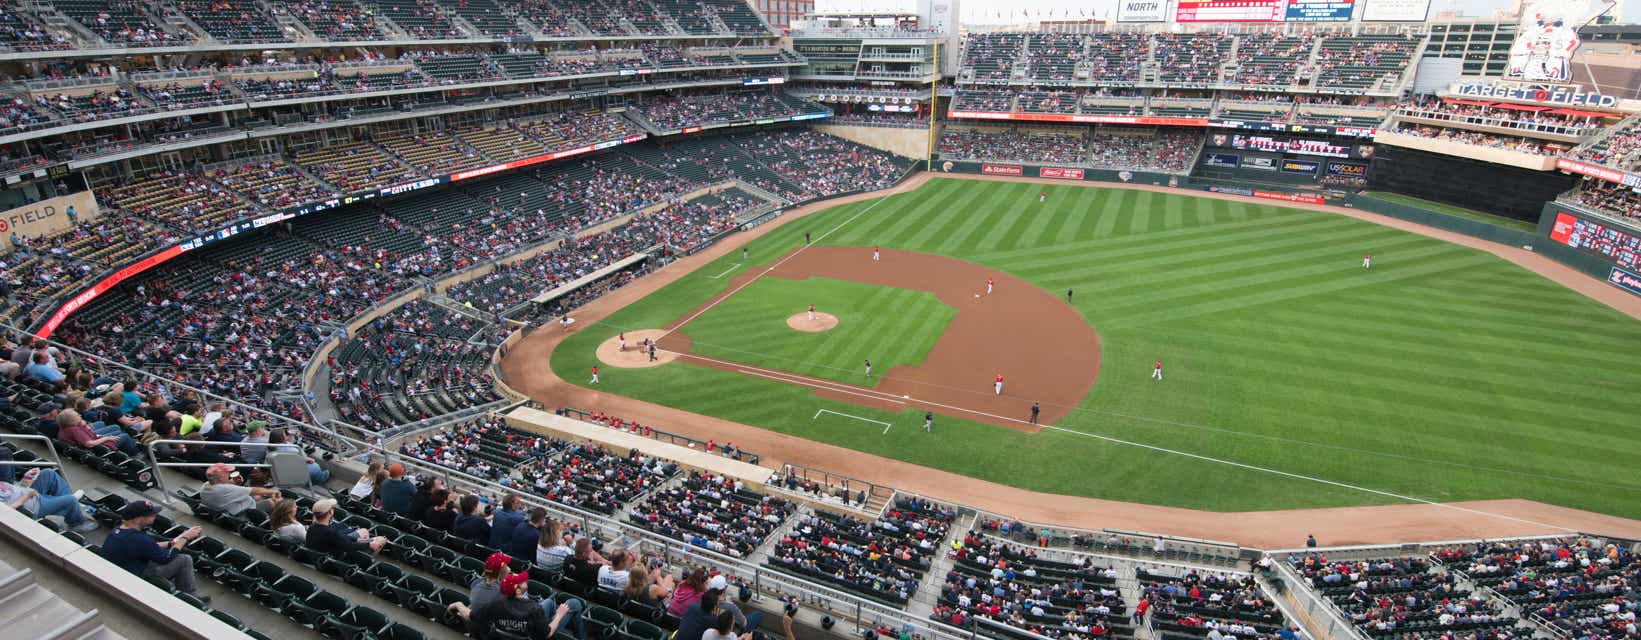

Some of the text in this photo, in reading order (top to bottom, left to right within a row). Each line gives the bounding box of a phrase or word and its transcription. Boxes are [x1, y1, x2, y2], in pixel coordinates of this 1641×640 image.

[1126, 2, 1158, 12] NORTH
[1458, 84, 1617, 109] TARGET FIELD
[1284, 163, 1317, 171] SUBWAY
[9, 205, 57, 228] FIELD
